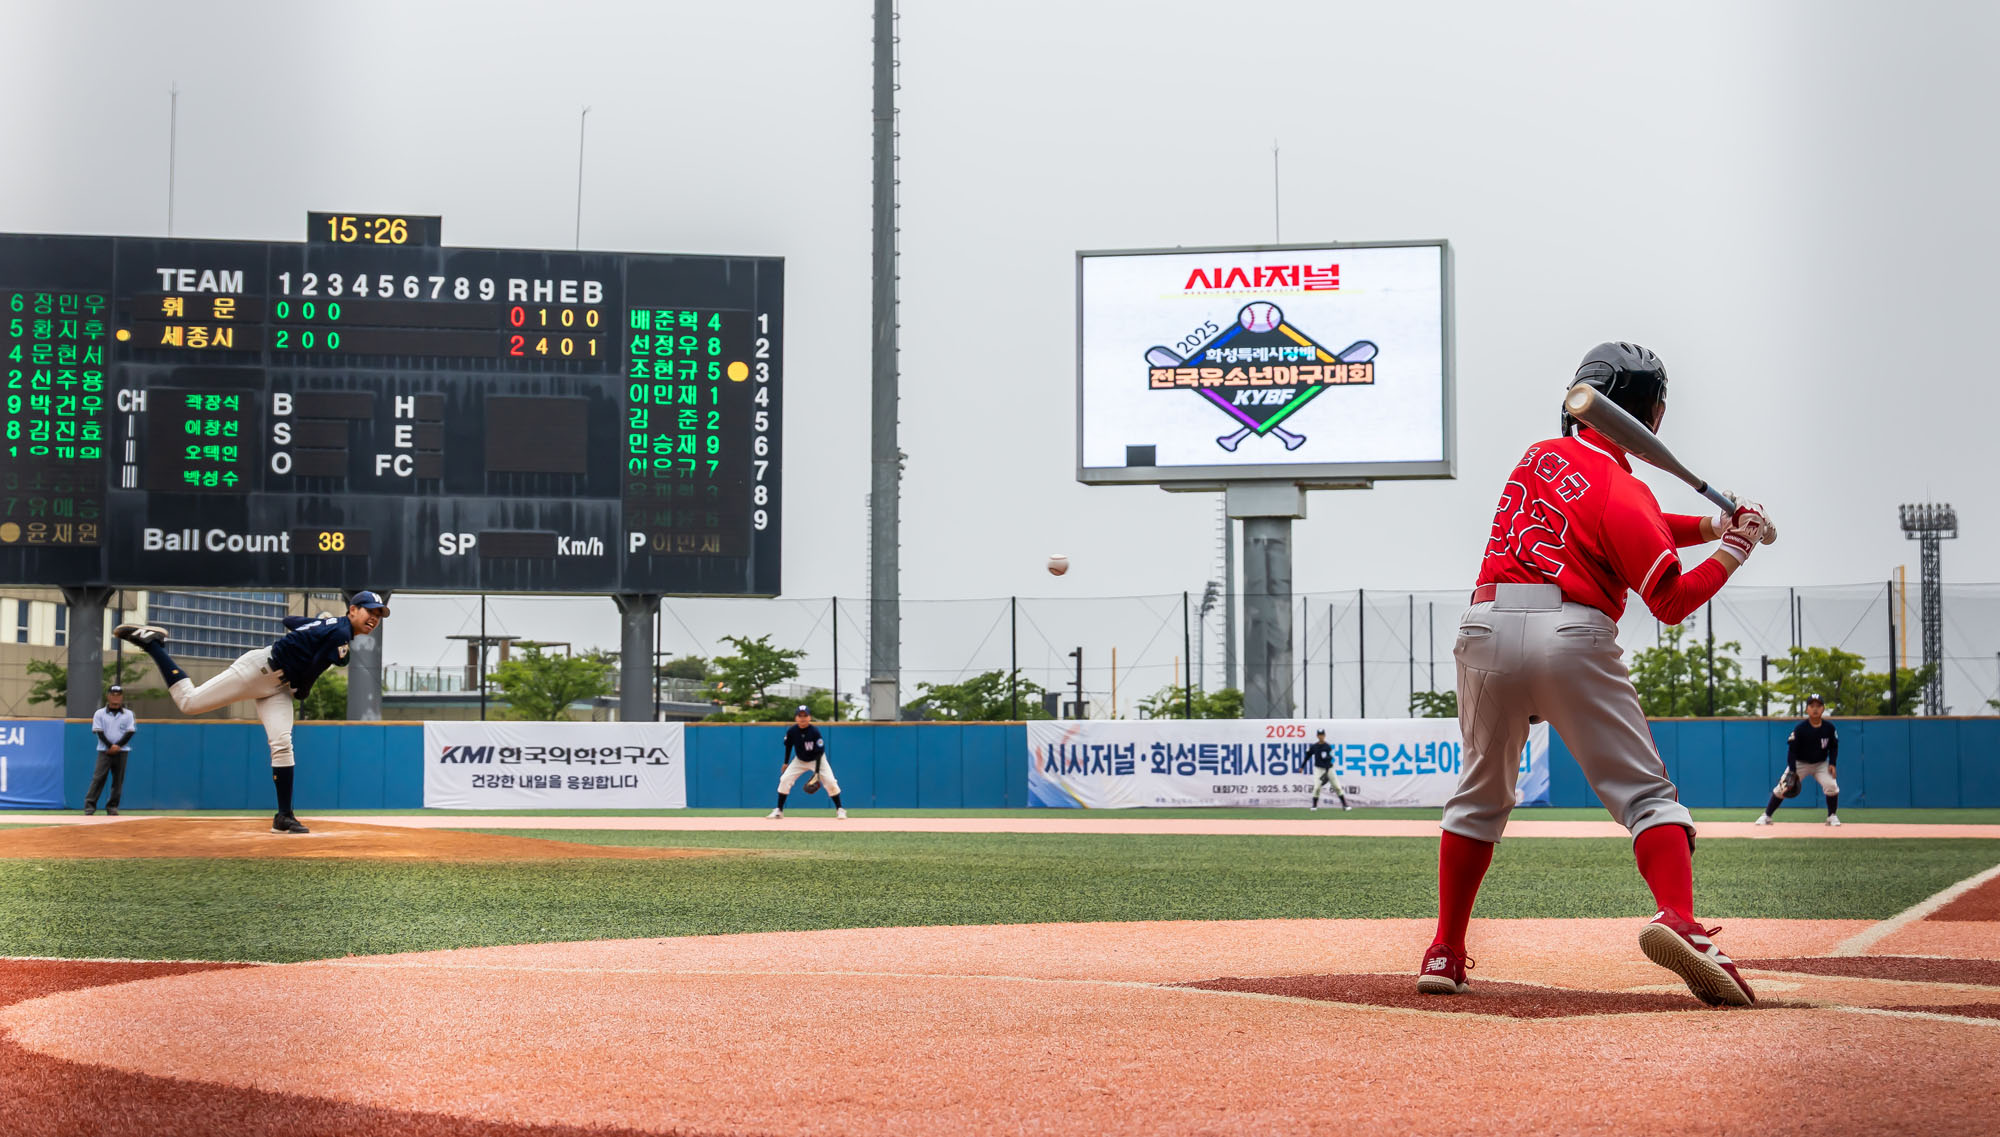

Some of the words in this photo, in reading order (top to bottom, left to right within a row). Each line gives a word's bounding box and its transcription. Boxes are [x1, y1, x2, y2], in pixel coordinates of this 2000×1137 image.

[328, 217, 407, 243] 15:26
[157, 268, 242, 293] TEAM
[279, 272, 289, 294] 1
[302, 273, 317, 295] 2
[328, 274, 342, 296] 3
[353, 274, 368, 297] 4
[379, 275, 393, 297] 5
[404, 276, 419, 298] 6
[429, 277, 445, 299] 7
[454, 277, 469, 299] 8
[480, 278, 494, 300] 9
[1184, 264, 1340, 291] 시사저널
[11, 294, 23, 312] 6
[35, 293, 104, 314] 장민우
[162, 297, 183, 316] 휘
[213, 298, 235, 318] 문
[277, 302, 289, 318] 0
[303, 302, 314, 319] 0
[328, 303, 340, 320] 0
[511, 306, 525, 327] 0
[540, 309, 546, 325] 1
[562, 310, 574, 326] 0
[587, 310, 598, 327] 0
[631, 310, 697, 331] 배준혁
[708, 313, 721, 331] 4
[758, 314, 767, 333] 1
[10, 319, 23, 337] 5
[33, 320, 104, 340] 황지후
[161, 326, 232, 348] 세종시
[277, 331, 288, 348] 2
[302, 332, 314, 348] 0
[328, 332, 339, 349] 0
[1177, 320, 1219, 354] 2025
[9, 345, 22, 362] 4
[32, 344, 101, 365] 문현서
[510, 335, 524, 356] 2
[536, 338, 548, 354] 4
[561, 338, 573, 355] 0
[589, 339, 595, 355] 1
[631, 335, 698, 356] 선정우
[708, 337, 721, 355] 8
[756, 338, 769, 358] 2
[1206, 346, 1317, 363] 화성특례시장배
[630, 359, 697, 380] 조현규
[708, 362, 720, 380] 5
[756, 363, 769, 382] 3
[1151, 364, 1374, 388] 전국유소년야구대회
[8, 370, 22, 388] 2
[31, 370, 103, 391] 신주용
[118, 389, 146, 411] CH
[274, 393, 292, 415] B
[630, 384, 696, 405] 이민재
[711, 387, 717, 404] 1
[755, 387, 769, 407] 4
[1231, 389, 1297, 406] KYBF
[8, 395, 21, 414] 9
[31, 395, 102, 416] 박건우
[395, 396, 414, 418] H
[629, 408, 648, 428] 김
[678, 410, 698, 429] 준
[707, 411, 719, 429] 2
[755, 412, 768, 431] 5
[7, 421, 20, 439] 8
[30, 420, 101, 441] 김진효
[274, 423, 291, 444] S
[395, 425, 412, 447] E
[629, 434, 696, 454] 민승재
[707, 436, 719, 454] 9
[755, 436, 768, 456] 6
[376, 455, 413, 476] FC
[706, 460, 719, 478] 7
[754, 461, 768, 480] 7
[1516, 447, 1591, 502] 현규
[754, 485, 767, 505] 8
[754, 510, 767, 530] 9
[27, 522, 97, 543] 윤재원
[144, 528, 199, 551] Ball
[206, 529, 289, 553] Count
[319, 532, 344, 551] 38
[630, 533, 646, 553] P
[439, 533, 476, 555] SP
[558, 537, 603, 556] Km/h
[1266, 725, 1306, 739] 2025
[440, 746, 494, 764] KMI
[499, 746, 670, 766] 한국의학연구소
[804, 741, 814, 751] W
[1044, 742, 1136, 777] 시사저널
[471, 774, 515, 789] 건강한
[519, 774, 562, 789] 내일을
[567, 775, 639, 790] 응원합니다
